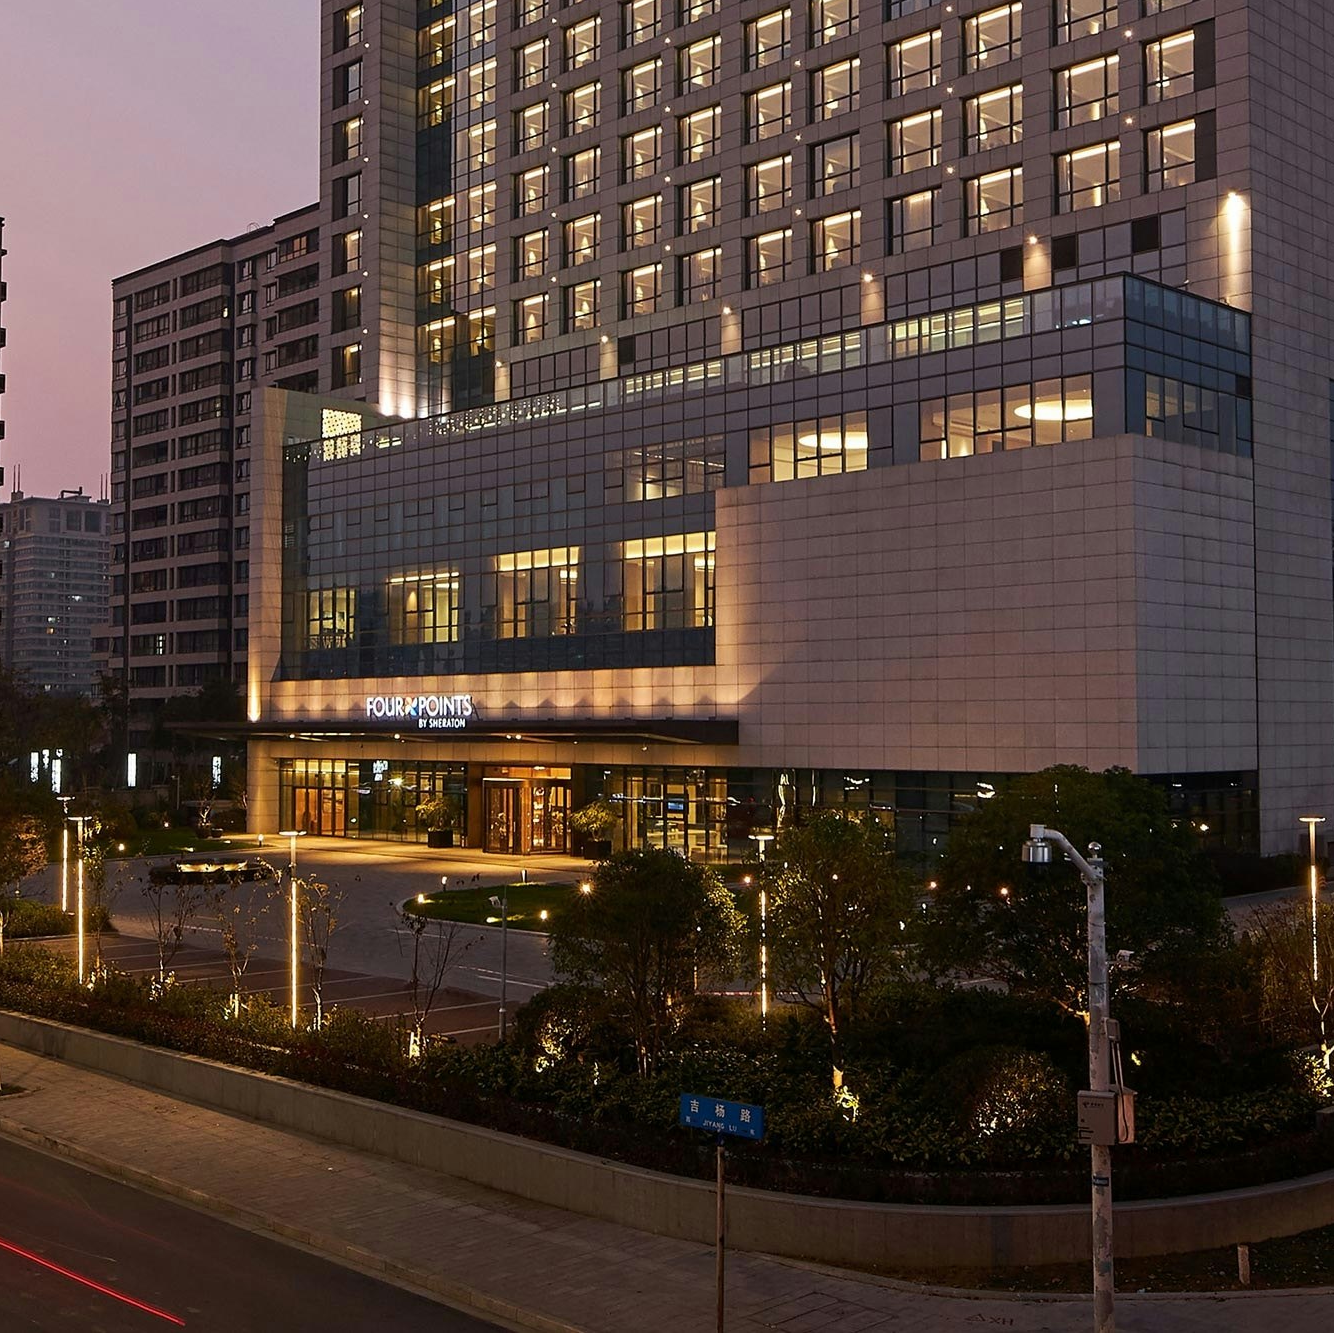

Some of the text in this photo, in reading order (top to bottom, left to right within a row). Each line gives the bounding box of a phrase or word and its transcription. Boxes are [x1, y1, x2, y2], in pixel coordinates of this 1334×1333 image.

[366, 694, 473, 717] FOUR POINTS
[418, 718, 466, 729] BY SHERATON
[689, 1099, 751, 1123] 吉杨路
[702, 1119, 725, 1130] JIYANG
